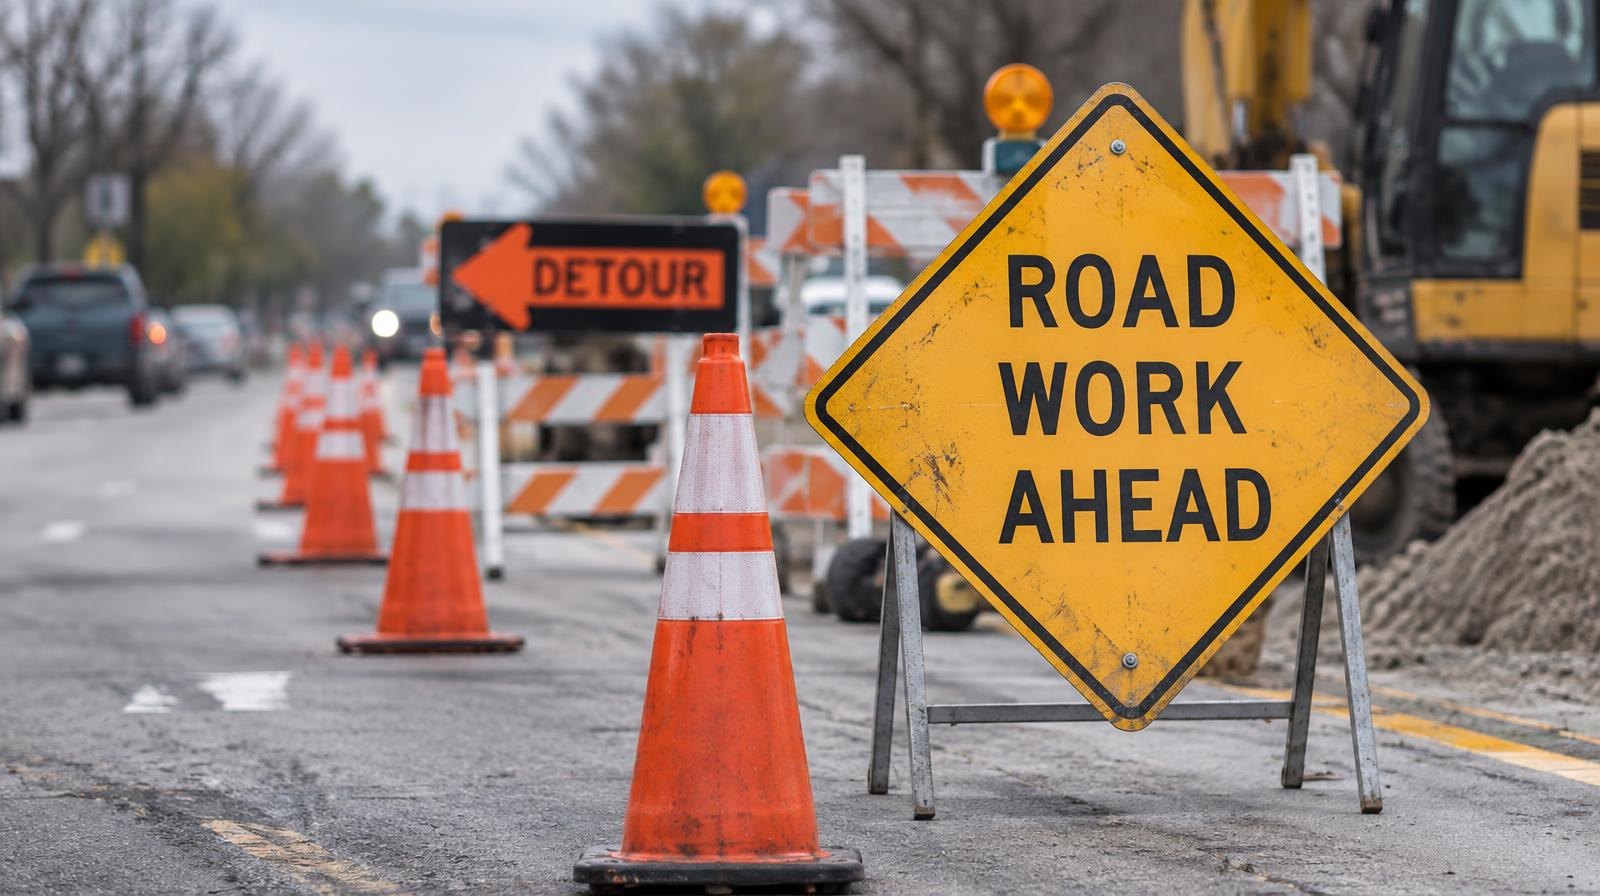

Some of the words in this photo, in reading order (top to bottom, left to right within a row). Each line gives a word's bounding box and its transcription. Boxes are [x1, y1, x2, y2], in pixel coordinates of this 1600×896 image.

[532, 256, 708, 299] DETOUR
[1007, 253, 1236, 330] ROAD
[997, 360, 1248, 437] WORK
[998, 467, 1272, 545] AHEAD
